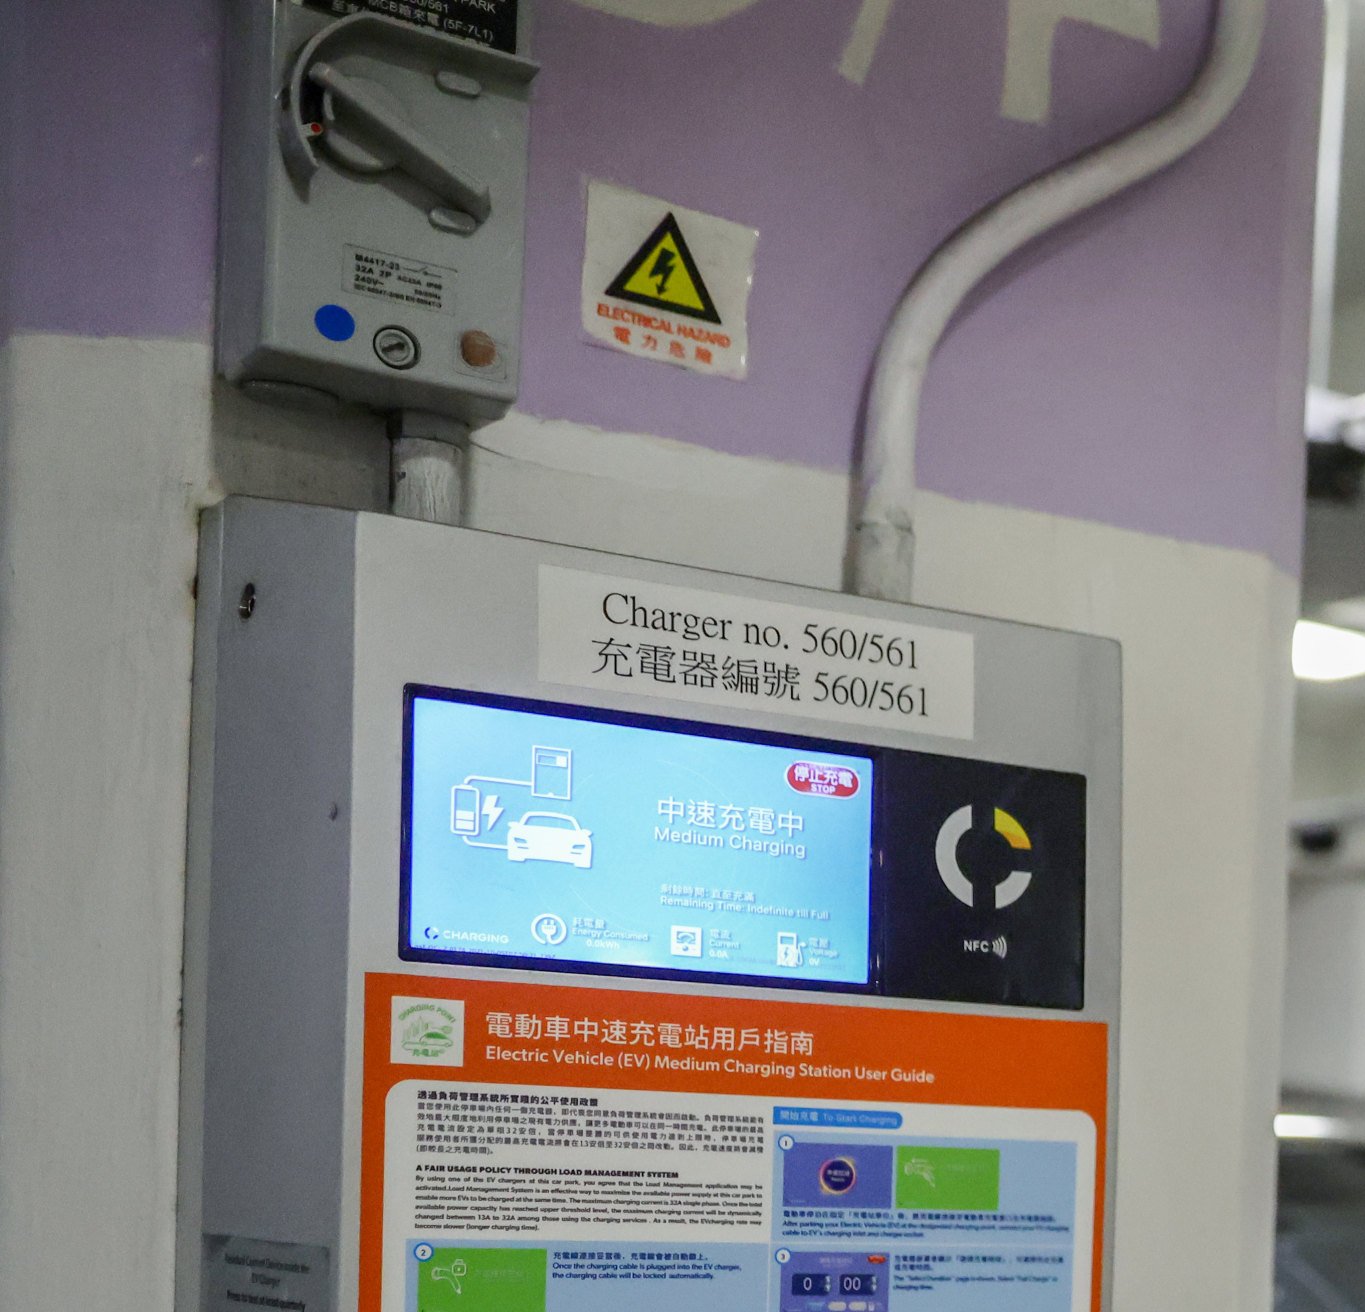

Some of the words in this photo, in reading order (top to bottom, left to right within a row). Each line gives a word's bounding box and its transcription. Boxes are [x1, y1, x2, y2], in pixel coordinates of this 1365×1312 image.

[597, 303, 674, 334] ELECTRICAL
[677, 322, 731, 349] HAZARD
[613, 325, 712, 364] 電力危險
[602, 592, 733, 641] Charger
[744, 620, 789, 650] no.
[802, 624, 919, 669] 560/561
[591, 637, 801, 701] 充電器編號
[813, 671, 928, 717] 560/561
[794, 765, 854, 788] 停止充電
[811, 784, 836, 794] STOP
[657, 795, 804, 838] 中速充電中
[654, 826, 724, 848] Medium
[729, 834, 807, 859] Charging
[660, 896, 714, 912] Remaining
[717, 901, 744, 913] Time:
[747, 903, 794, 917] Indefinite
[797, 908, 809, 918] till
[811, 910, 829, 920] Full
[443, 930, 509, 944] CHARGING
[572, 927, 602, 939] Energy
[603, 930, 649, 942] Consumed
[709, 939, 741, 950] Current
[963, 940, 989, 953] NFC
[398, 1004, 435, 1020] CHARGING
[436, 1007, 456, 1023] POINT
[485, 1011, 814, 1056] 電動車中速充電站用戶指南
[486, 1045, 548, 1063] Electric
[552, 1049, 614, 1066] Vehicle
[617, 1052, 651, 1071] (EV)
[654, 1056, 720, 1072] Medium
[723, 1058, 795, 1079] Charging
[799, 1063, 851, 1079] Station
[854, 1067, 887, 1082] User
[890, 1067, 935, 1084] Guide
[823, 1112, 833, 1121] To
[836, 1112, 857, 1122] Start
[859, 1114, 898, 1126] Charging
[416, 1164, 423, 1172] A
[424, 1165, 445, 1173] FAIR
[447, 1165, 477, 1173] USAGE
[479, 1166, 512, 1174] POLICY
[513, 1167, 557, 1175] THROUGH
[559, 1168, 582, 1176] LOAD
[584, 1169, 645, 1177] MANAGEMENT
[647, 1171, 679, 1179] SYSTEM
[420, 1249, 426, 1257] 2
[552, 1271, 564, 1279] the
[565, 1271, 597, 1280] charging
[669, 1272, 714, 1280] automatically.
[573, 1262, 585, 1270] the
[586, 1262, 618, 1271] charging
[646, 1263, 676, 1271] plugged
[714, 1263, 742, 1272] charger,
[803, 1277, 812, 1291] 0
[843, 1277, 861, 1291] 00
